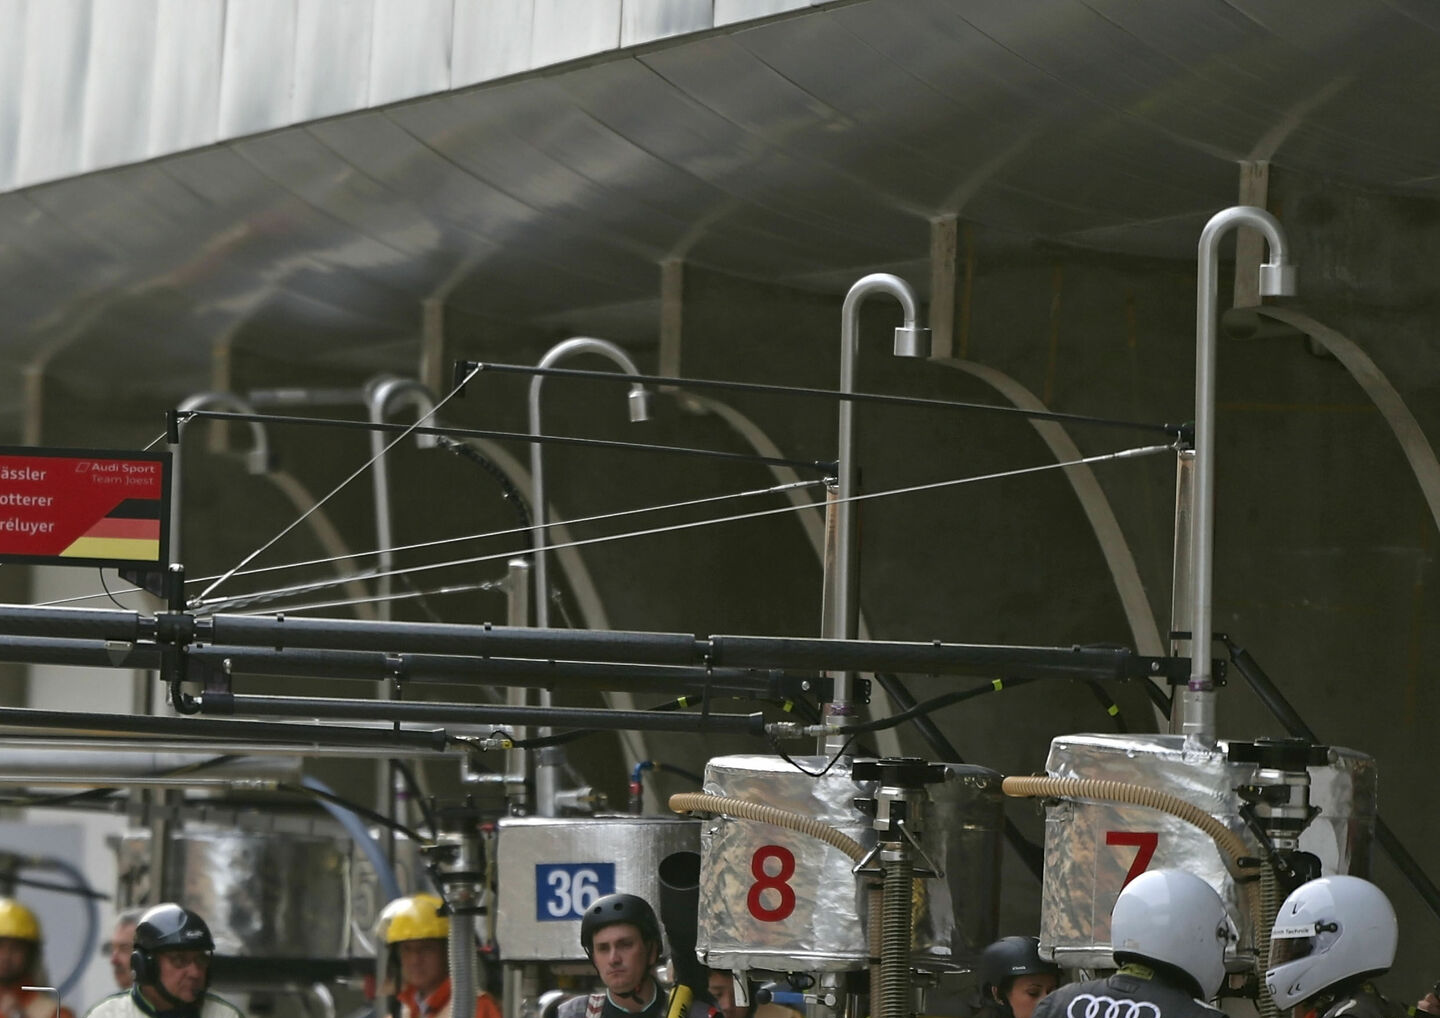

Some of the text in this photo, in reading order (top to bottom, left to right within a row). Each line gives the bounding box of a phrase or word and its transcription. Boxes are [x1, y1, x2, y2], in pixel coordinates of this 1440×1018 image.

[92, 463, 155, 474] Audi Sport
[547, 869, 600, 918] 36
[747, 845, 798, 923] 8
[1106, 832, 1158, 910] 7
